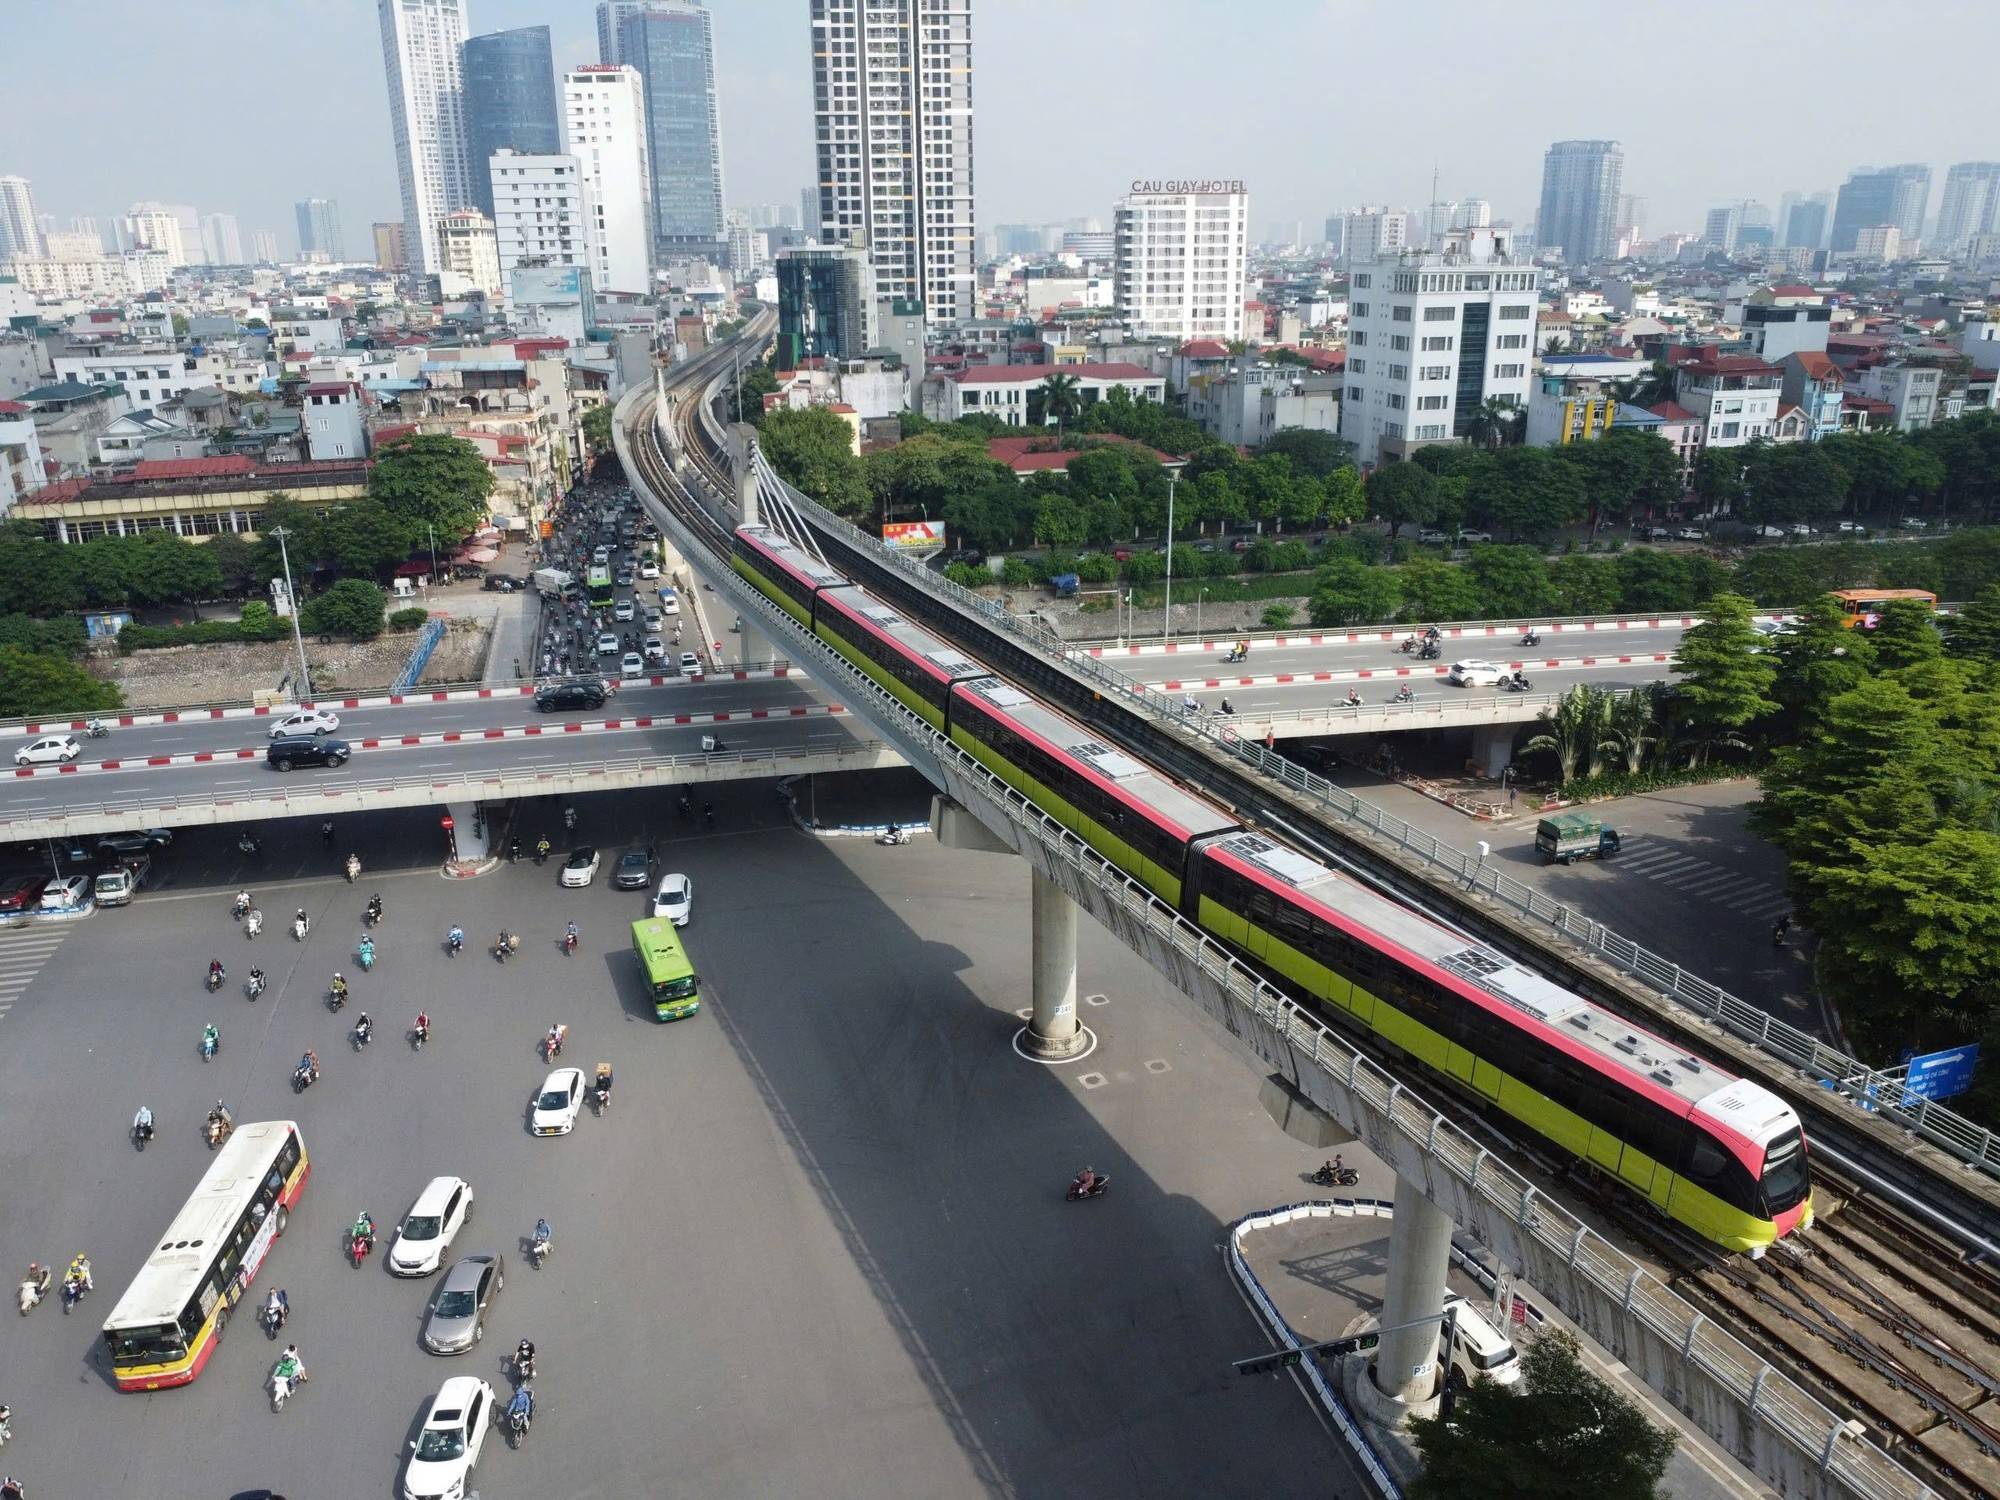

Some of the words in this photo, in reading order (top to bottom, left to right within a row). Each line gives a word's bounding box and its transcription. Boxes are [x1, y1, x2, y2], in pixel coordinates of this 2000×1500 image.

[1131, 180, 1162, 192] CAU
[1165, 180, 1199, 192] GIAY
[1201, 180, 1248, 192] HOTEL
